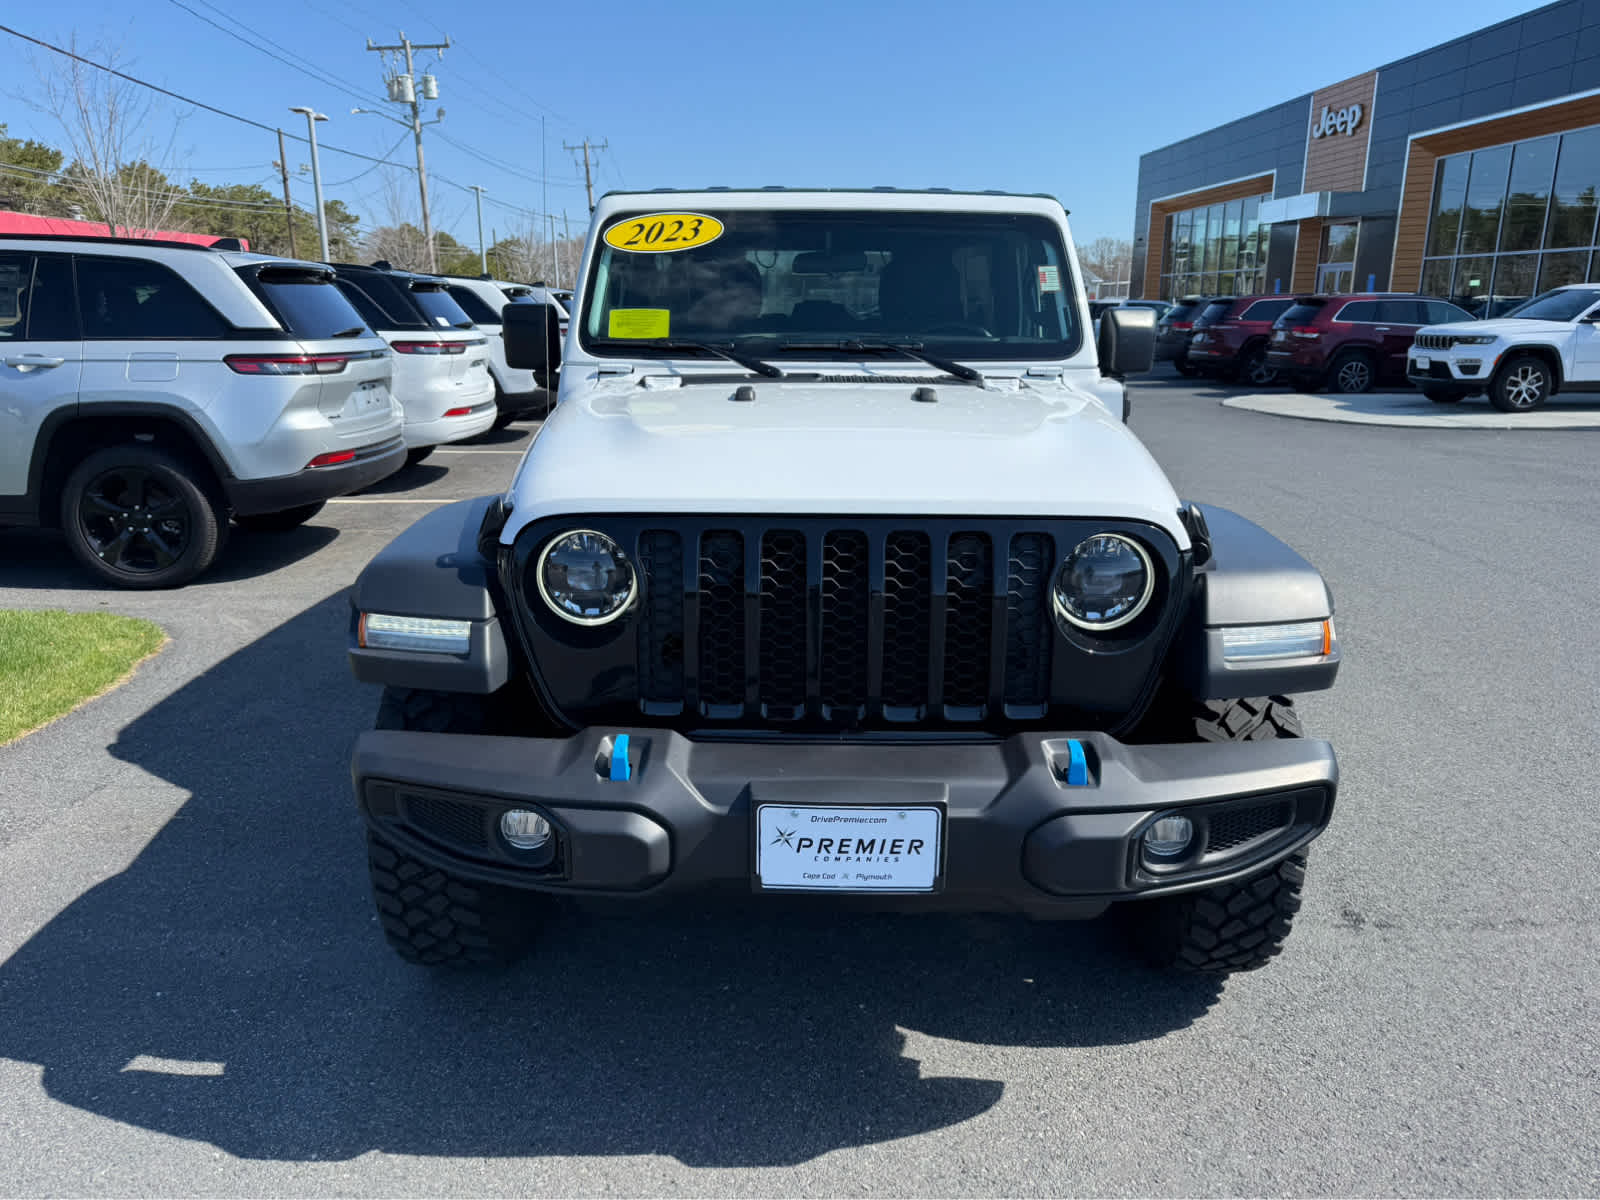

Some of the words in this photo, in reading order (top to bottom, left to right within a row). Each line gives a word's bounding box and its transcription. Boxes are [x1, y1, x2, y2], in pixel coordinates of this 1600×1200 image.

[1313, 104, 1362, 139] Jeep
[623, 218, 704, 246] 2023
[810, 815, 888, 824] DrivePremier.com
[796, 837, 925, 855] PREMIER
[802, 872, 821, 881] Cape
[822, 872, 836, 880] Cod
[855, 873, 893, 881] Plymouth
